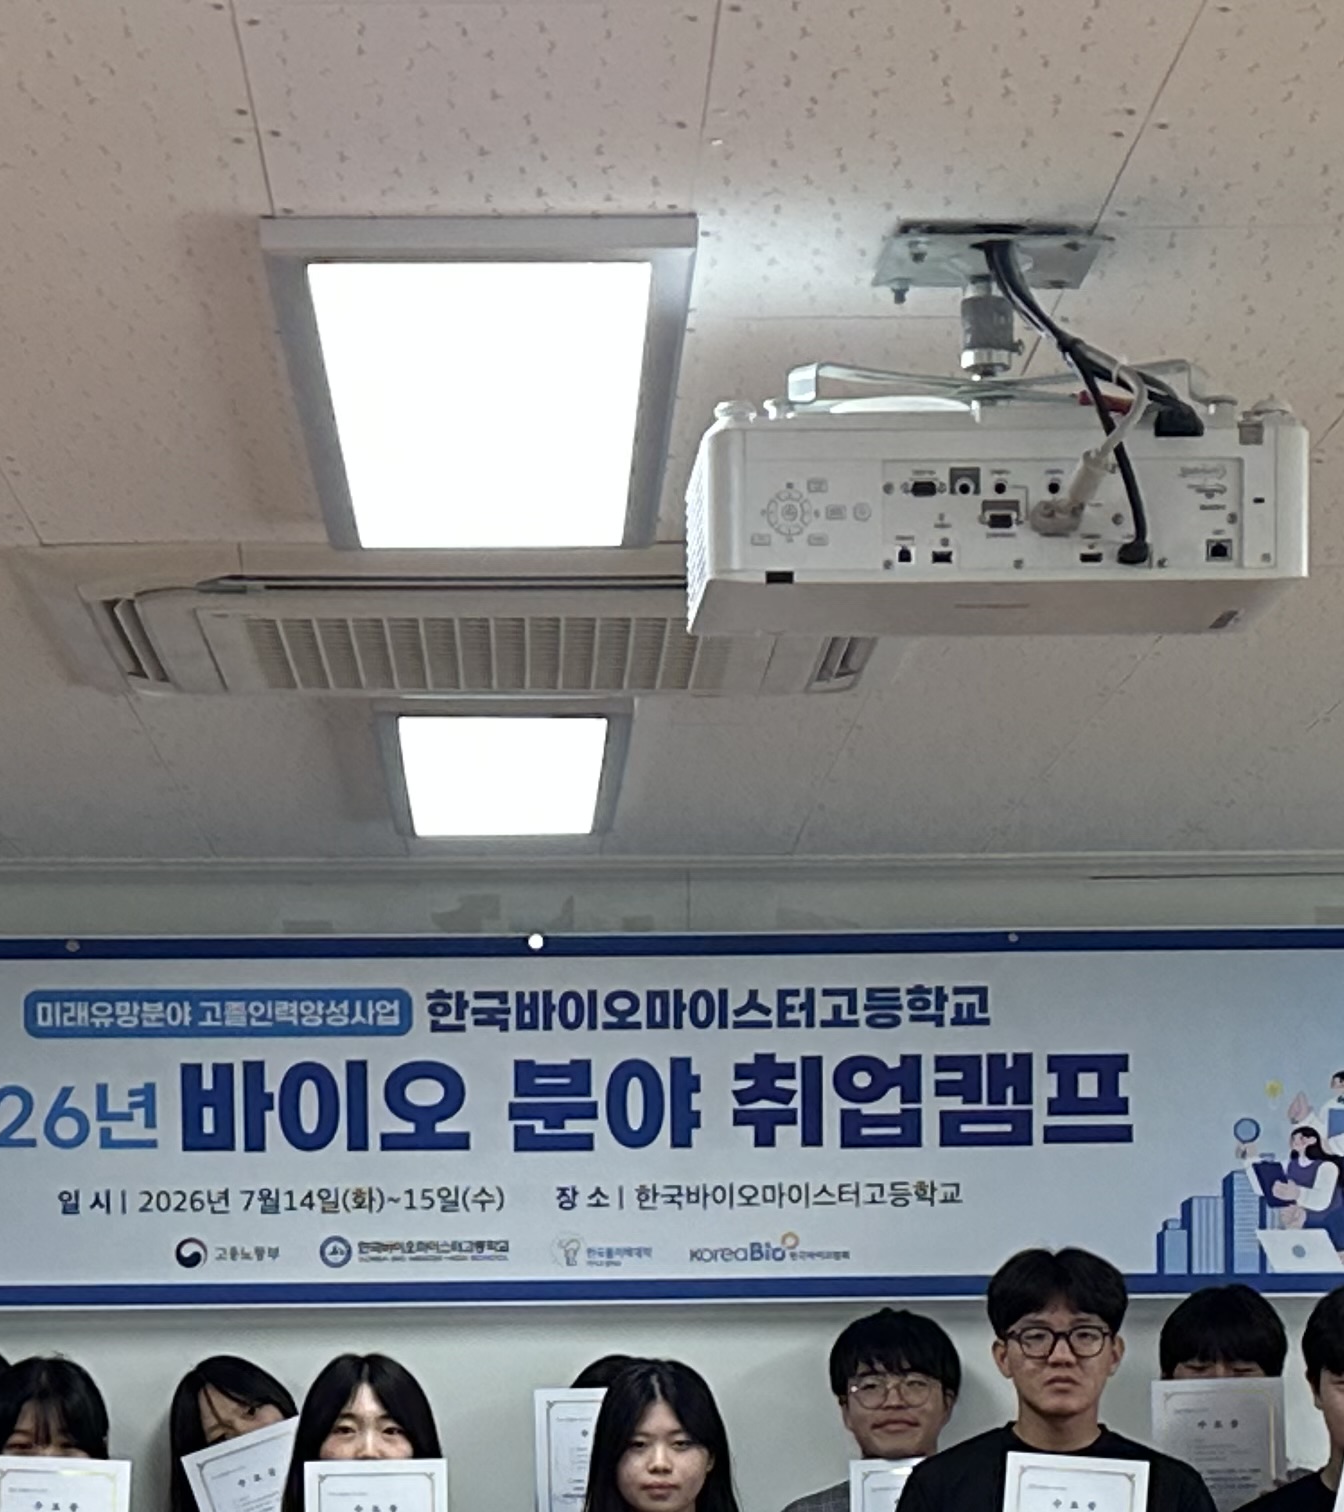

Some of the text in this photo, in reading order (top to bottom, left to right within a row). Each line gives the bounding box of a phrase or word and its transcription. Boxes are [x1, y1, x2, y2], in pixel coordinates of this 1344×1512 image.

[36, 984, 991, 1032] 미래유망분야 고졸인력양성사업 한국바이오마이스터고등학교
[180, 1059, 471, 1153] 바이오
[508, 1056, 702, 1153] 분야
[731, 1052, 1134, 1149] 취업캠프
[138, 1188, 230, 1215] 2026년
[239, 1185, 505, 1215] 7월14일(화)~15일(수)
[635, 1181, 963, 1210] 한국바이오마이스터고등학교
